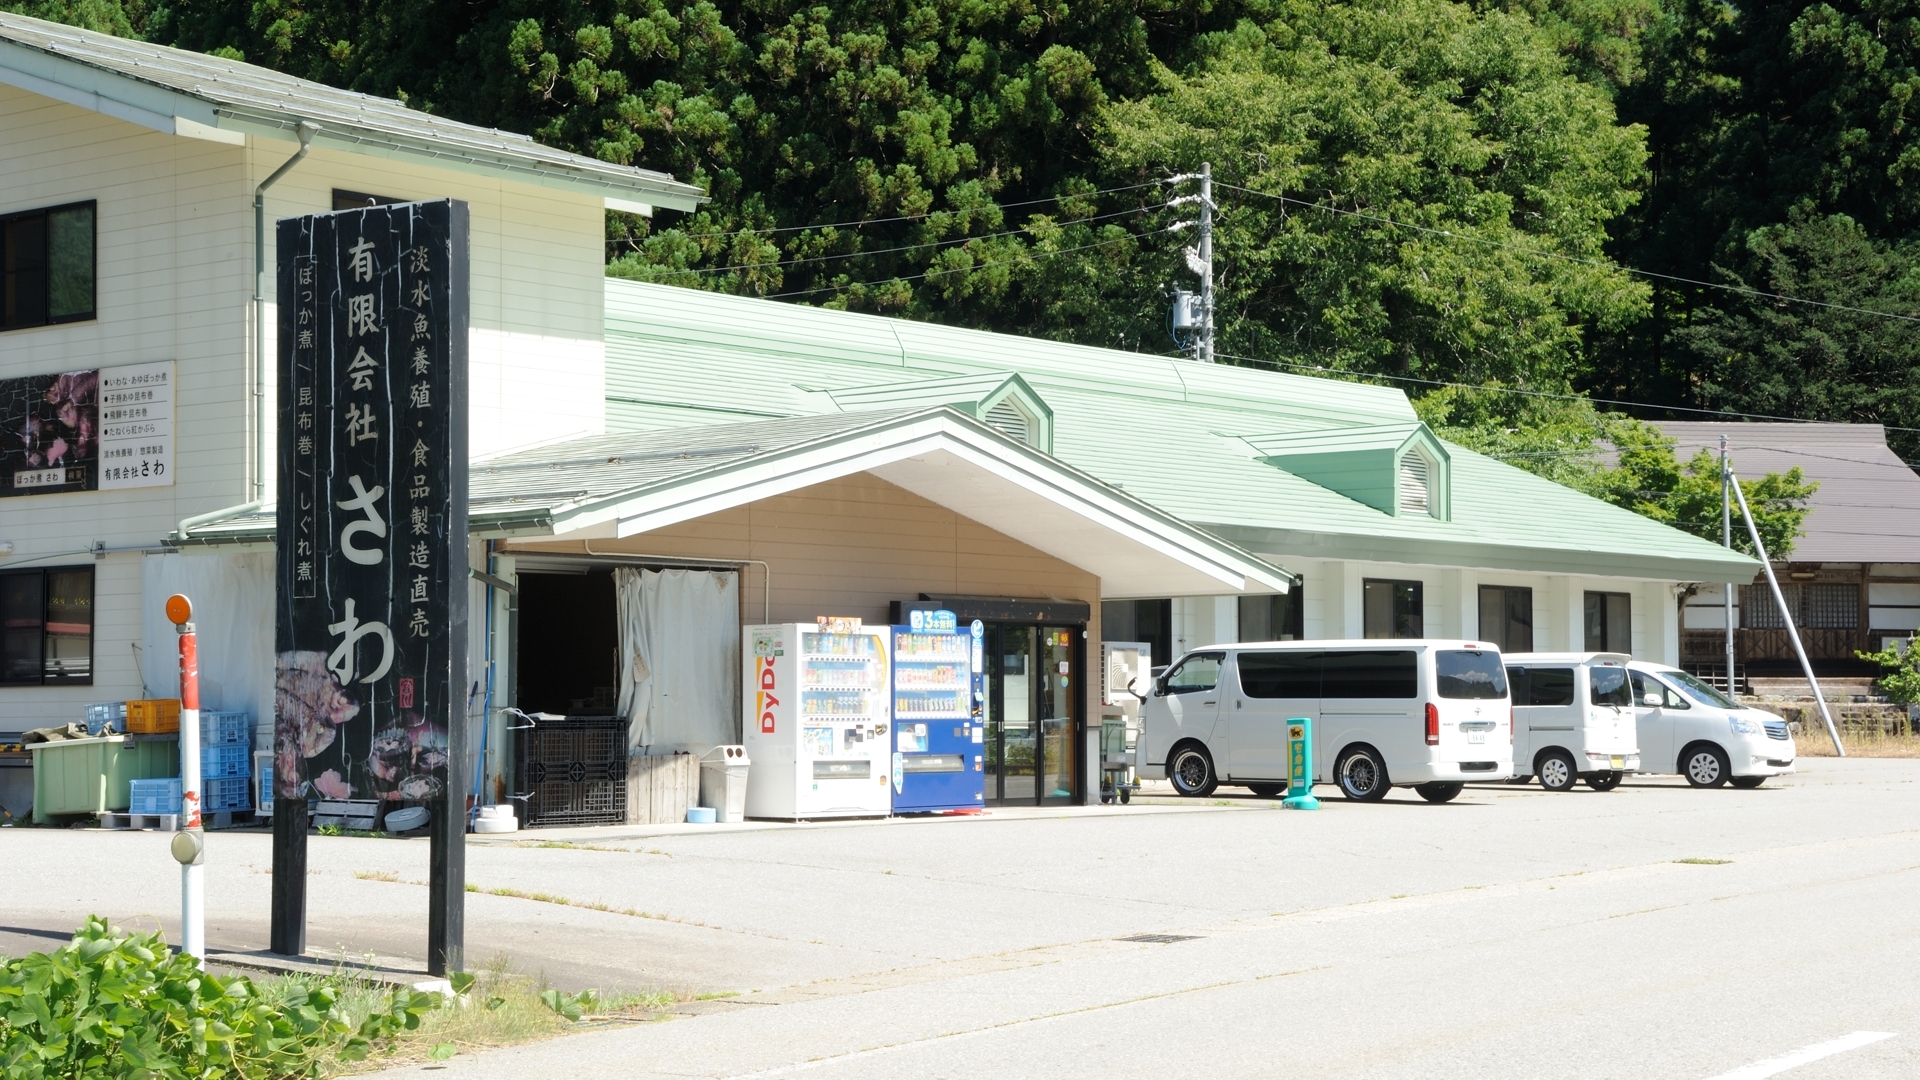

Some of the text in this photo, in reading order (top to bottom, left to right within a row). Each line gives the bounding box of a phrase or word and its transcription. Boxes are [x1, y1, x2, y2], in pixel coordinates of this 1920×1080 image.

[297, 267, 313, 349] ぼっか煮
[109, 390, 154, 404] 子持あゆ昆布巻
[109, 423, 156, 436] たねくら紅かぶら
[297, 387, 313, 455] 昆布巻
[103, 448, 133, 459] 淡水魚養殖
[140, 445, 164, 456] 惣菜製造
[408, 247, 432, 638] 淡水魚養殖・食品製造直売
[16, 472, 59, 485] ぼっか煮 さわ
[297, 492, 313, 581] しぐれ煮
